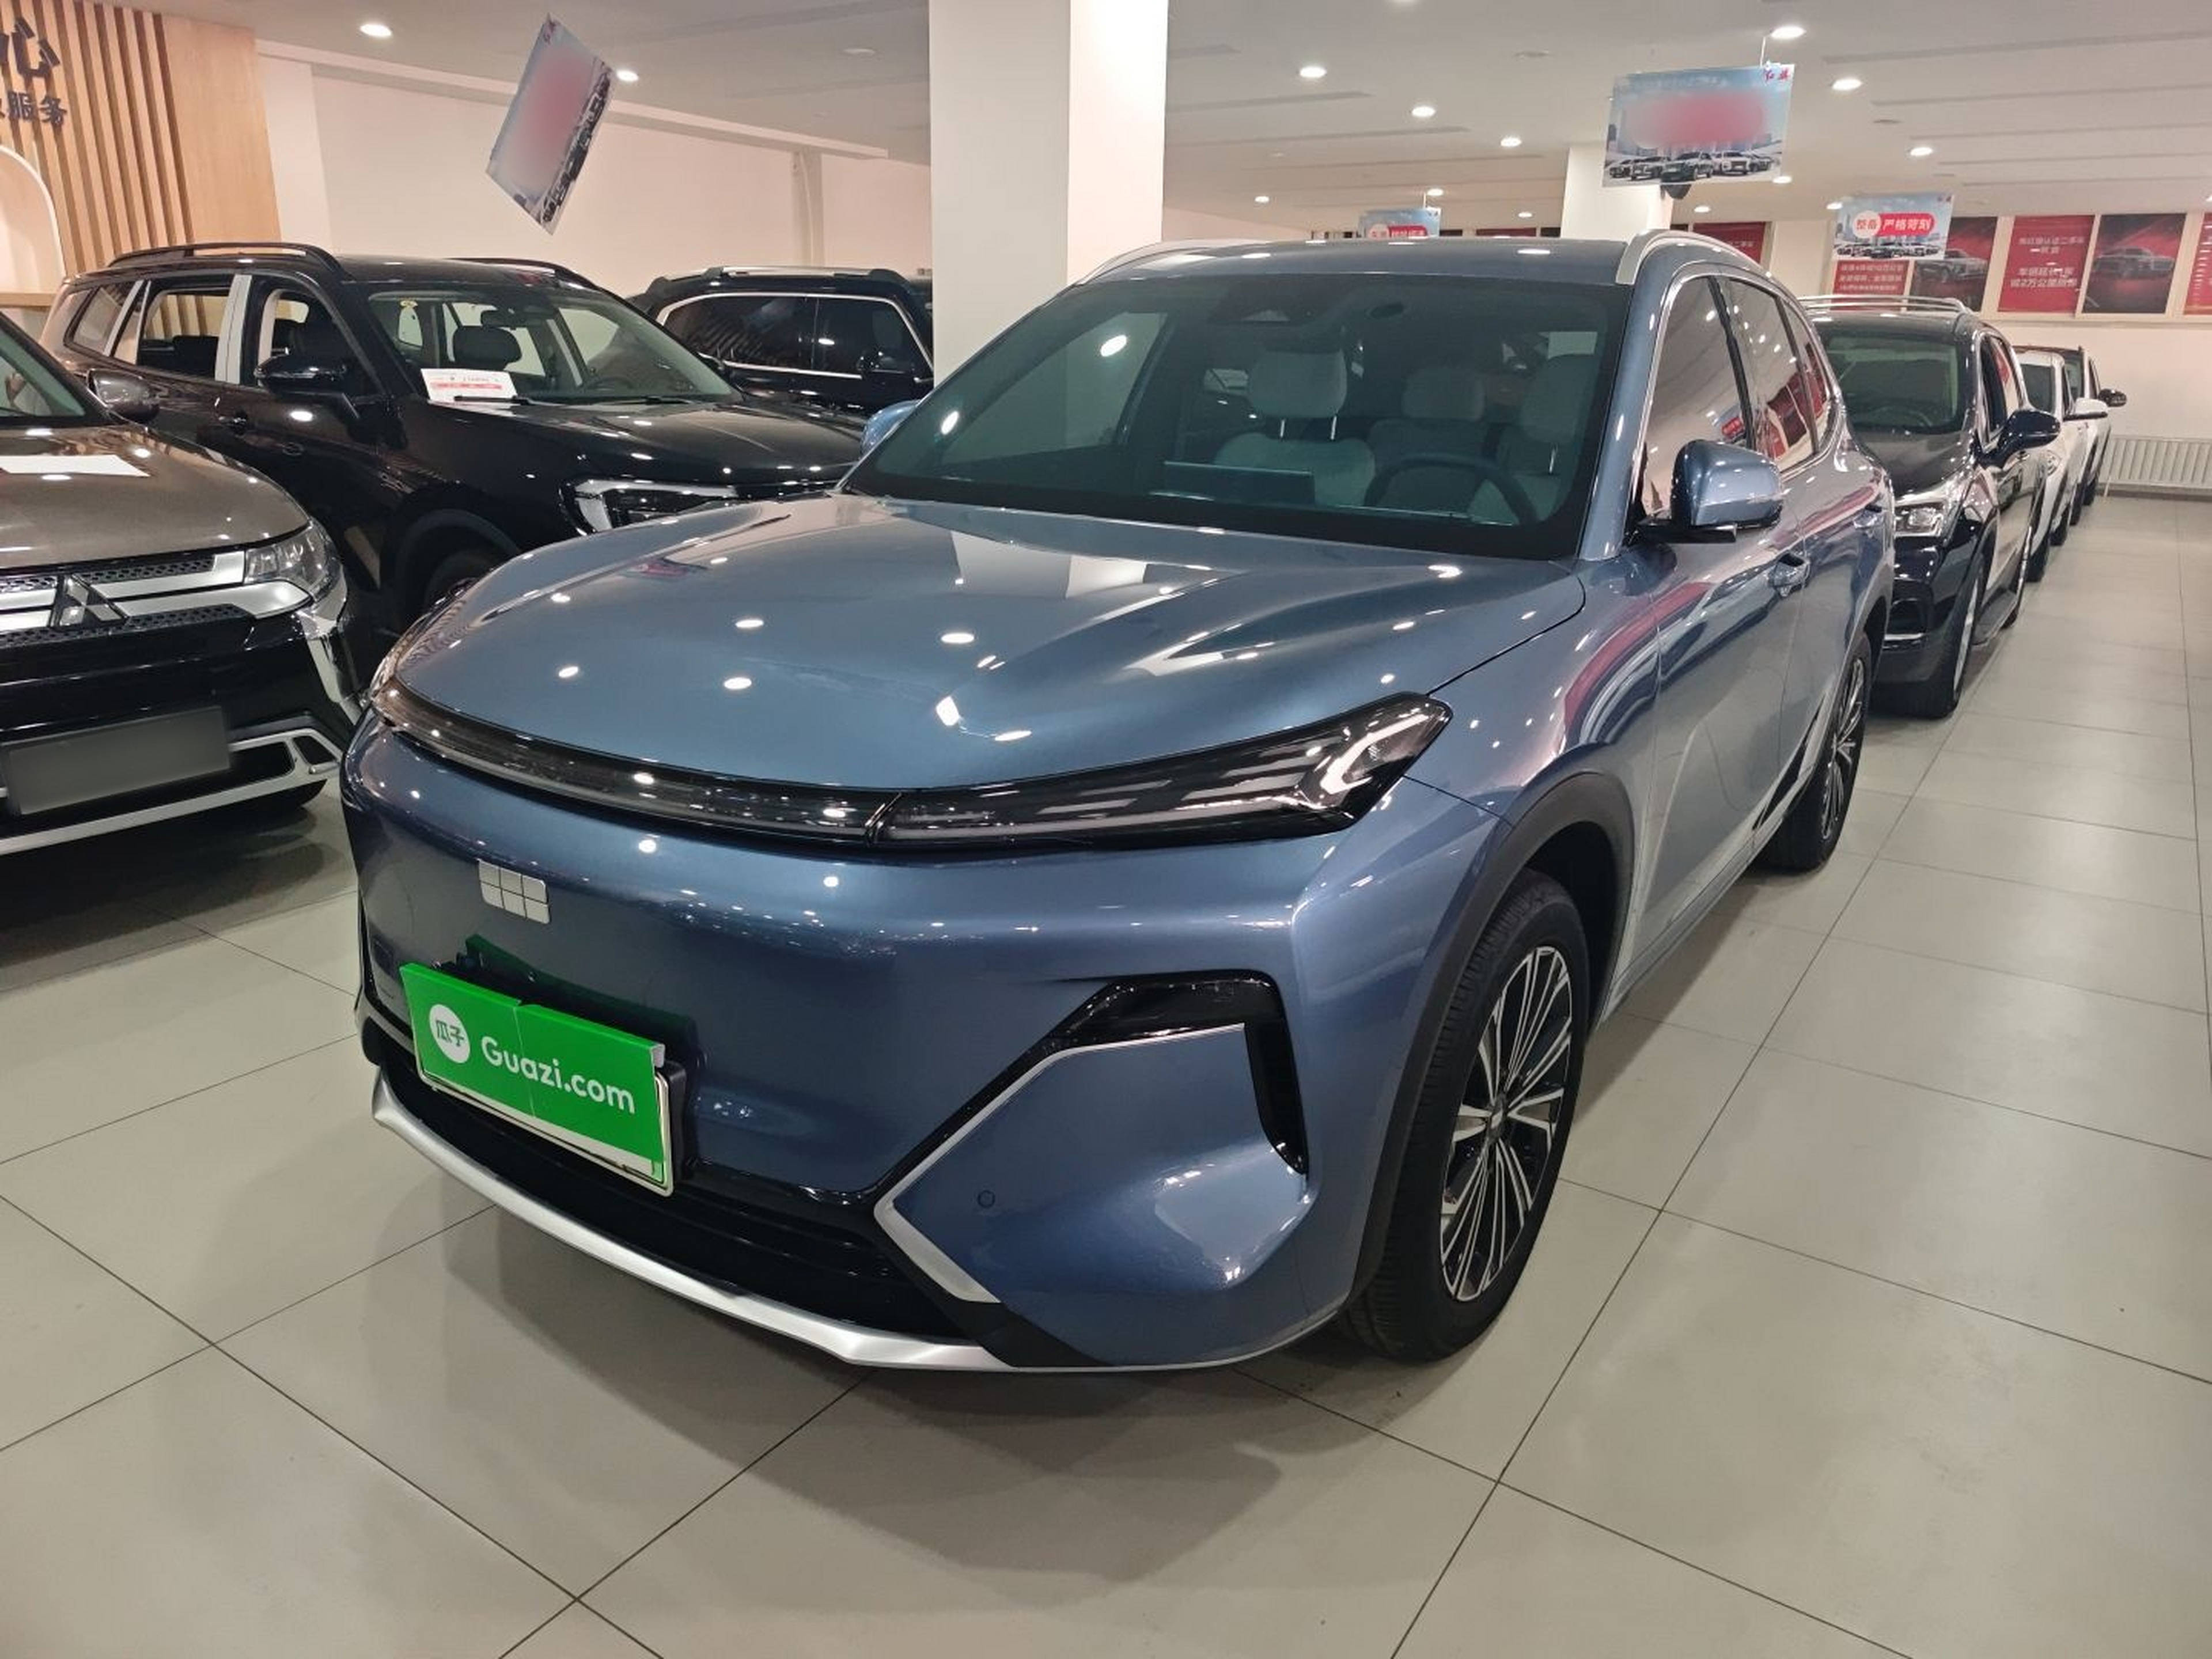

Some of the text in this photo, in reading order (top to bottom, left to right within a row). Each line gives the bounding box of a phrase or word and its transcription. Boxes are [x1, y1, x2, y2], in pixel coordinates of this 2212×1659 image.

[0, 17, 60, 78] 心
[0, 91, 68, 126] 服务
[435, 1019, 635, 1115] 瓜子 Guazi.com
